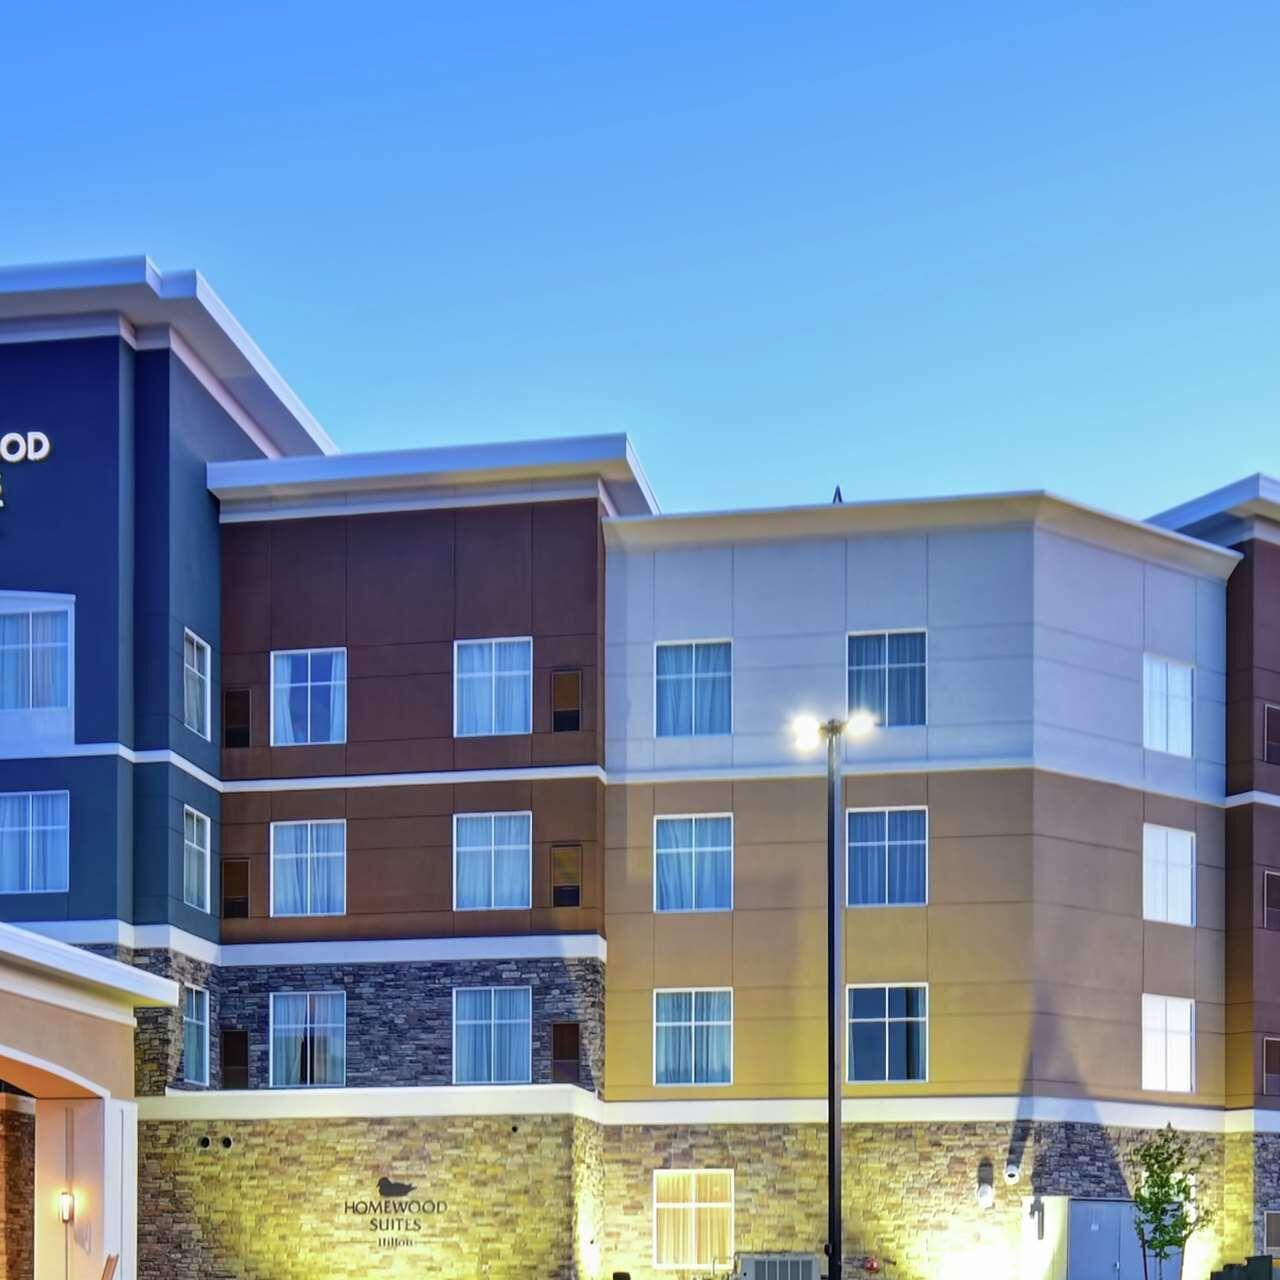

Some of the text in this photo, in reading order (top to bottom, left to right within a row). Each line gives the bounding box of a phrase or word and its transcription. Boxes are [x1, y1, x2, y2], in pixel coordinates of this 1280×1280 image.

[344, 1200, 448, 1215] HOMEWOOD
[369, 1217, 422, 1232] SUITES
[378, 1237, 413, 1247] Hilton
